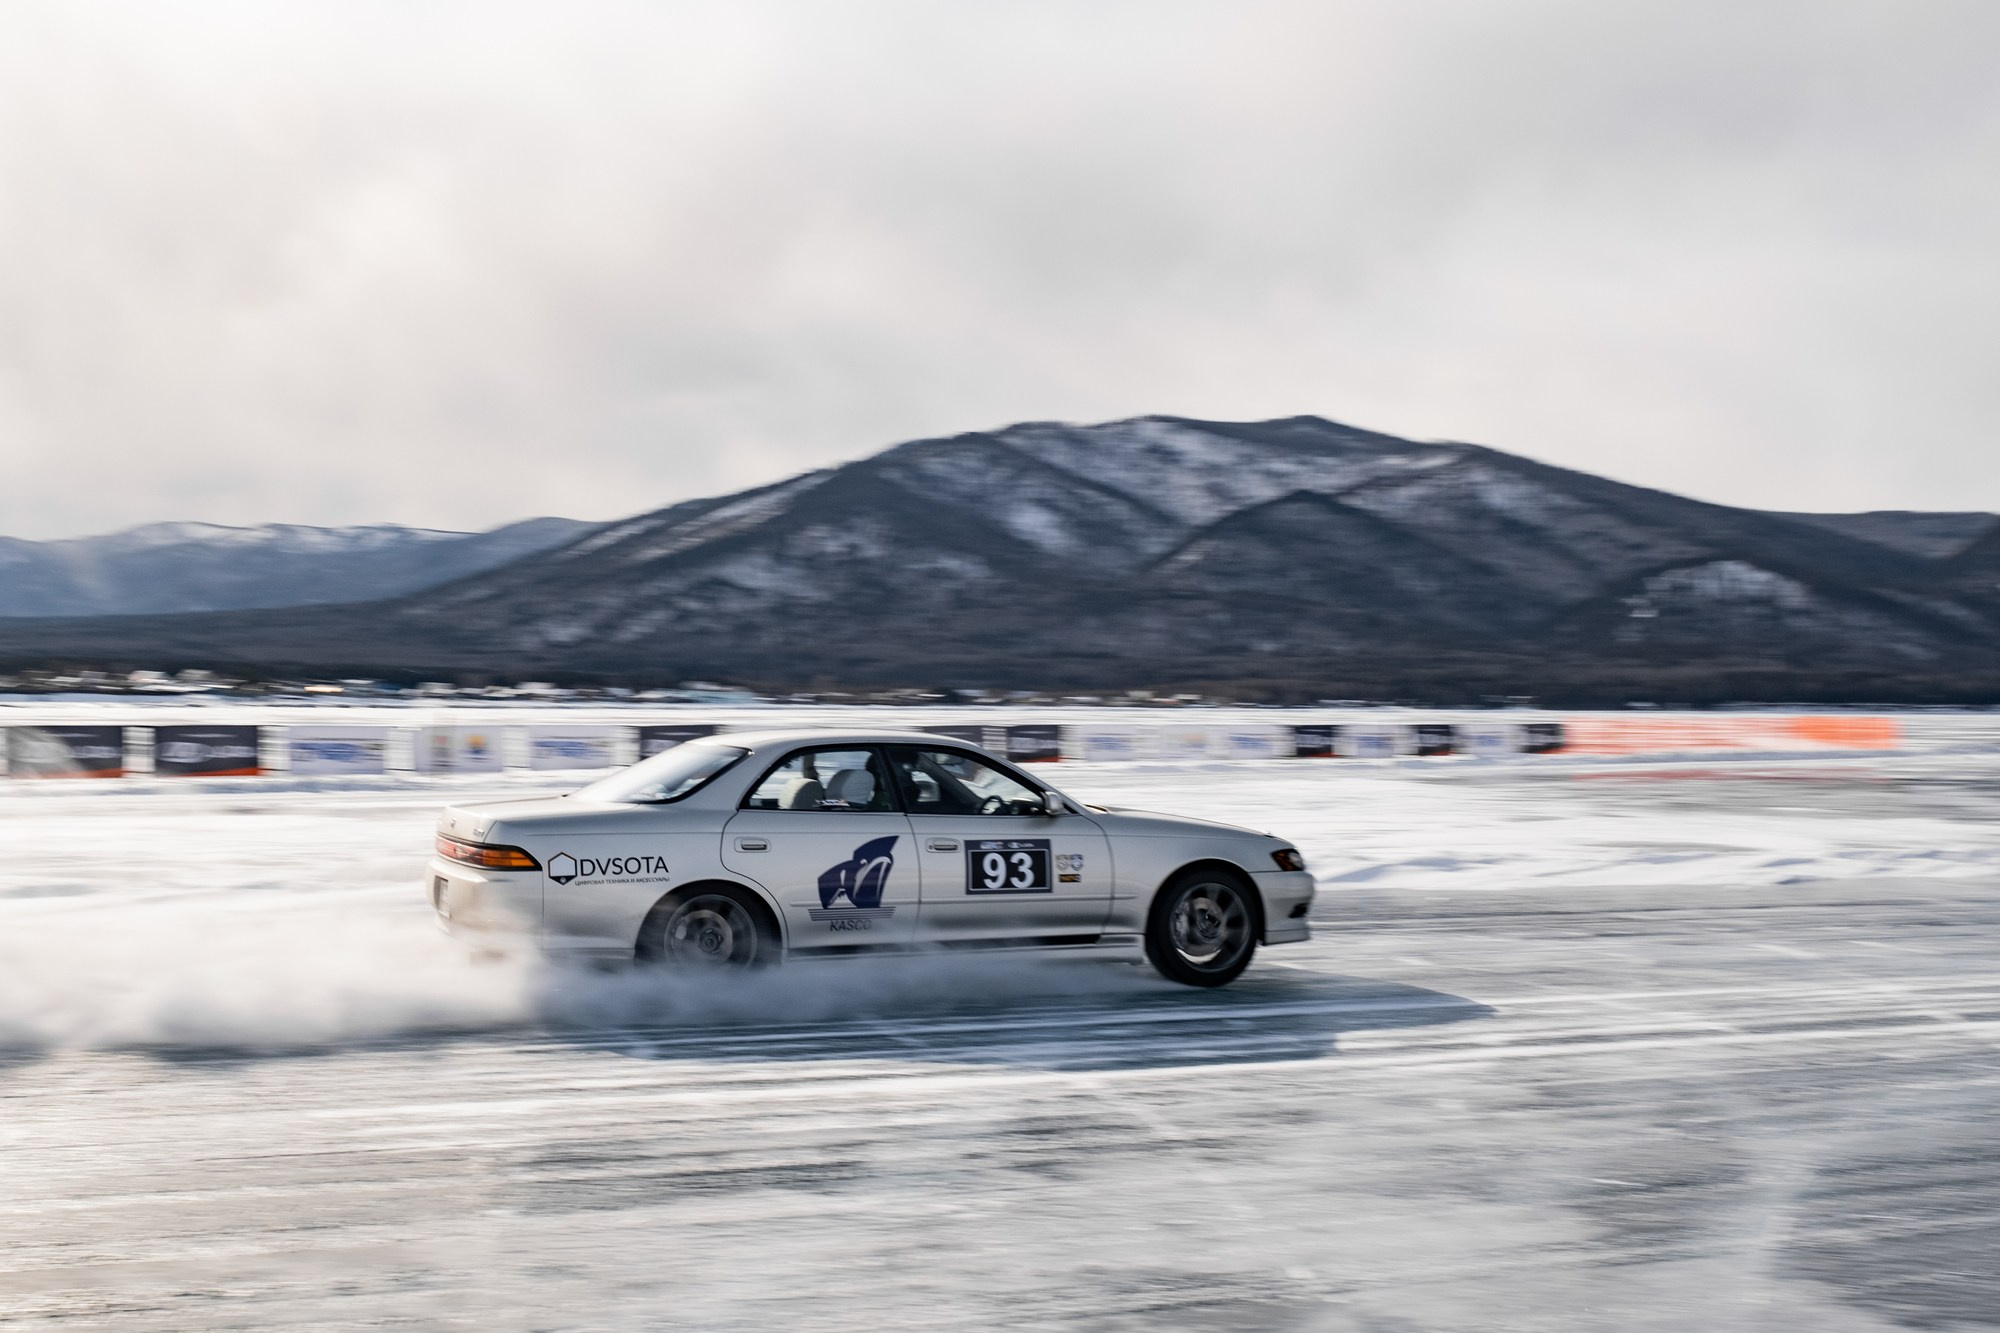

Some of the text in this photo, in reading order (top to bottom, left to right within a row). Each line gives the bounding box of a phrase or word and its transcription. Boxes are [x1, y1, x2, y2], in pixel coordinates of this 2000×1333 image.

[580, 856, 669, 876] DVSOTA
[982, 852, 1035, 889] 93
[829, 919, 872, 931] KASCO
